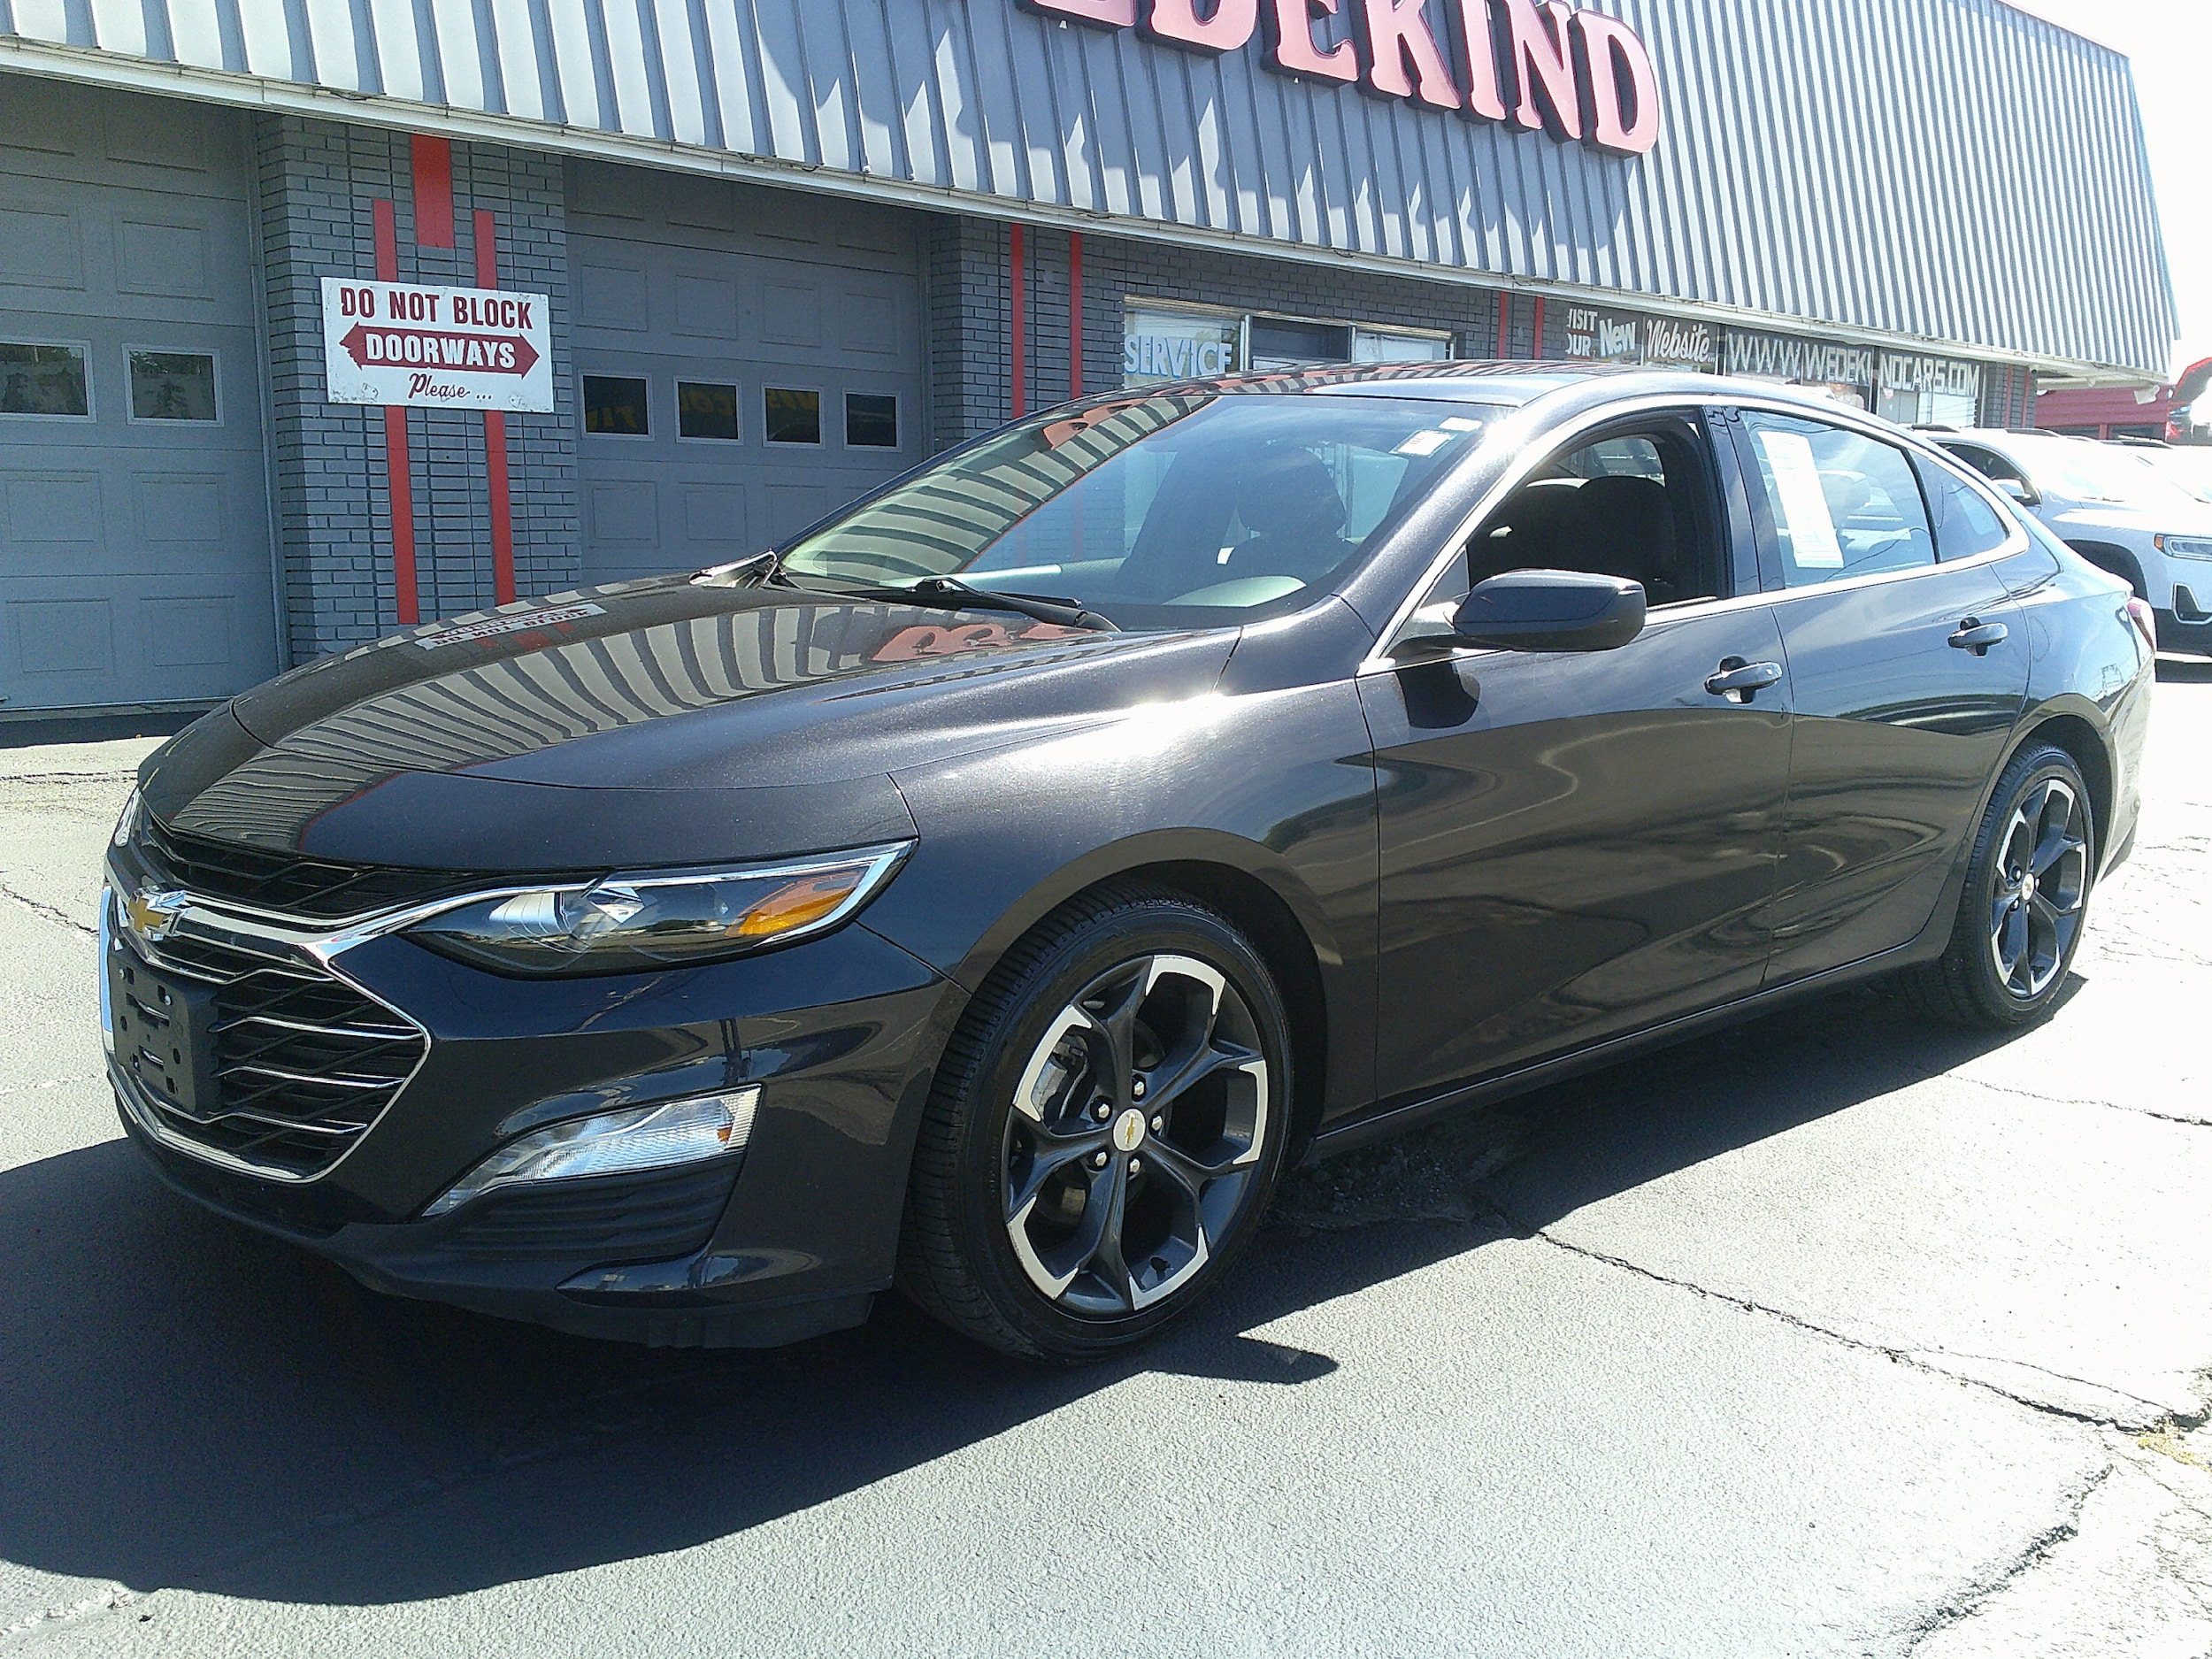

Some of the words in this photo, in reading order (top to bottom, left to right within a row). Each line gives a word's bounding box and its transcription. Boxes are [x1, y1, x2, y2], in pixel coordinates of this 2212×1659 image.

[340, 287, 374, 318] DO
[389, 290, 440, 322] NOT
[453, 296, 533, 329] BLOCK
[365, 333, 516, 369] DOORWAYS
[1125, 334, 1233, 379] SERVICE
[1599, 318, 1637, 357] New
[408, 373, 471, 399] Please
